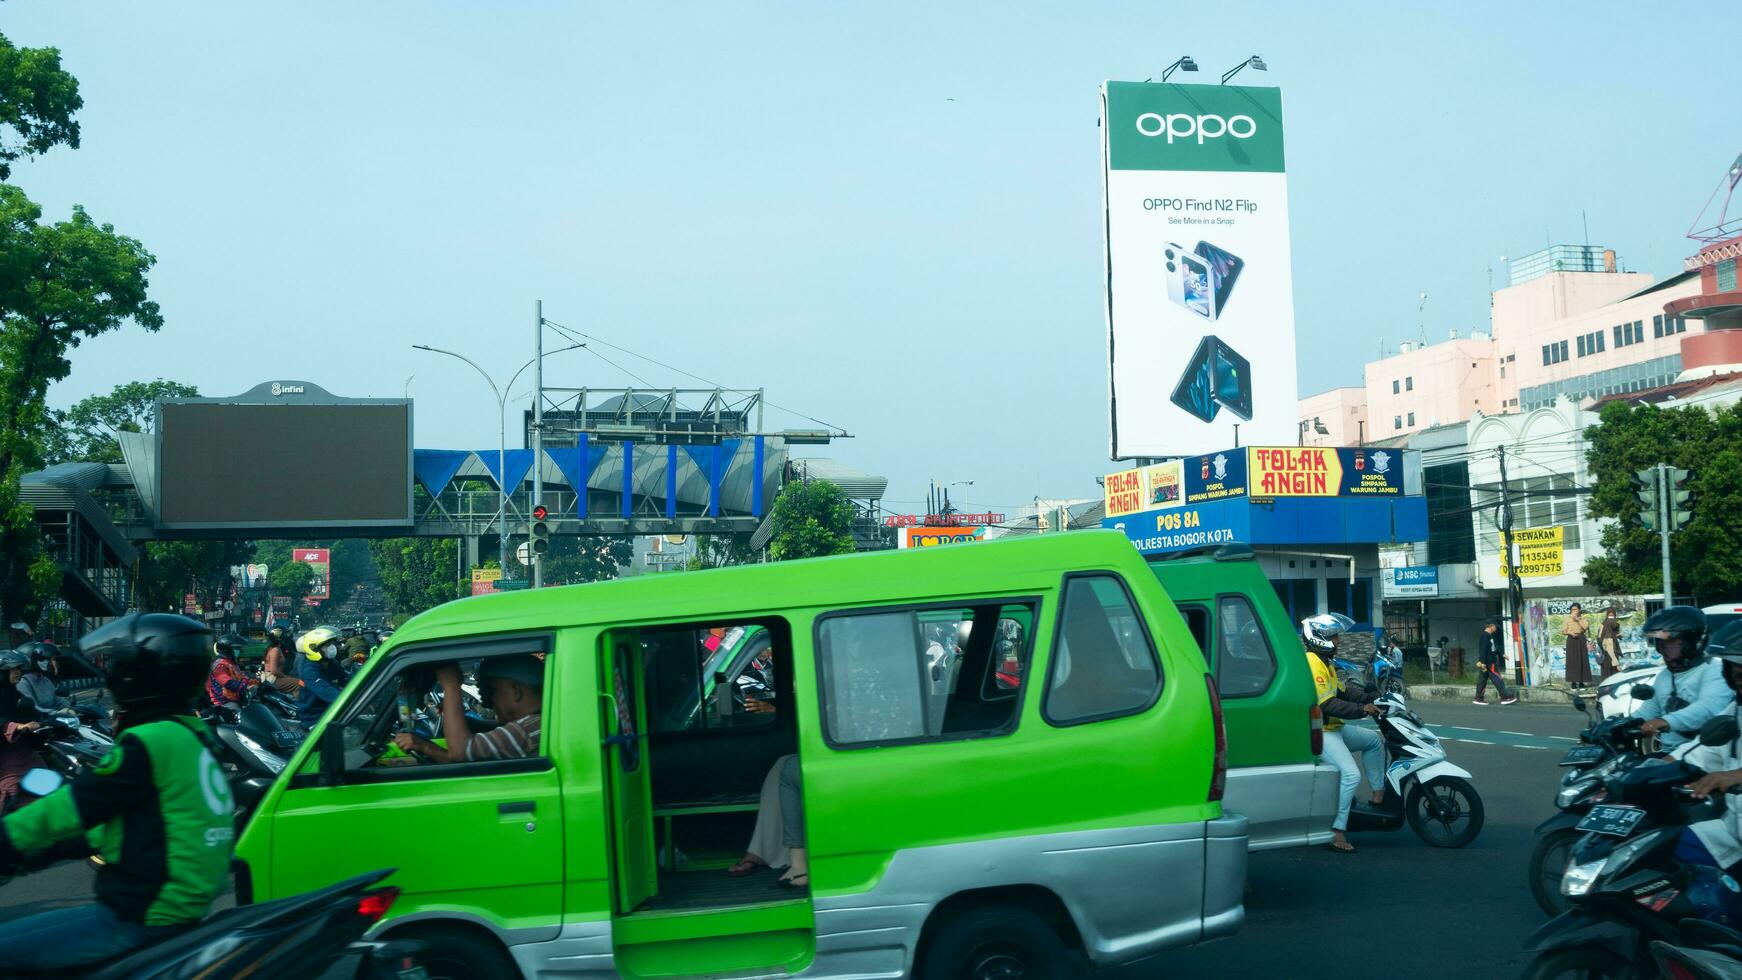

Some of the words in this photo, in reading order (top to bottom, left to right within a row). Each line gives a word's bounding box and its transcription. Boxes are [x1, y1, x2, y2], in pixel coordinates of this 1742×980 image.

[1143, 198, 1183, 211] OPPO
[1185, 199, 1212, 211] Find
[1215, 199, 1233, 211] N2
[1236, 199, 1258, 214] Flip
[1168, 217, 1182, 225] See
[1183, 217, 1202, 225] More
[1203, 217, 1209, 225] in
[1216, 217, 1235, 227] Snap
[282, 385, 304, 393] infini
[1256, 449, 1328, 471] TOLAK
[1106, 471, 1140, 494] TOLAK
[1206, 482, 1224, 491] POSPOL
[1261, 472, 1327, 494] ANGIN
[1188, 493, 1207, 502] SIMPANG
[1207, 491, 1227, 499] WARUNG
[1228, 487, 1244, 496] JAMBU
[1109, 491, 1140, 514] ANGIN
[885, 514, 917, 527] 489
[1156, 513, 1182, 532] POS
[1183, 510, 1201, 528] 8A
[1173, 532, 1206, 547] BOGOR
[1207, 529, 1234, 542] KOTA
[1517, 531, 1555, 541] SEWAKAN
[1404, 570, 1419, 580] NSC
